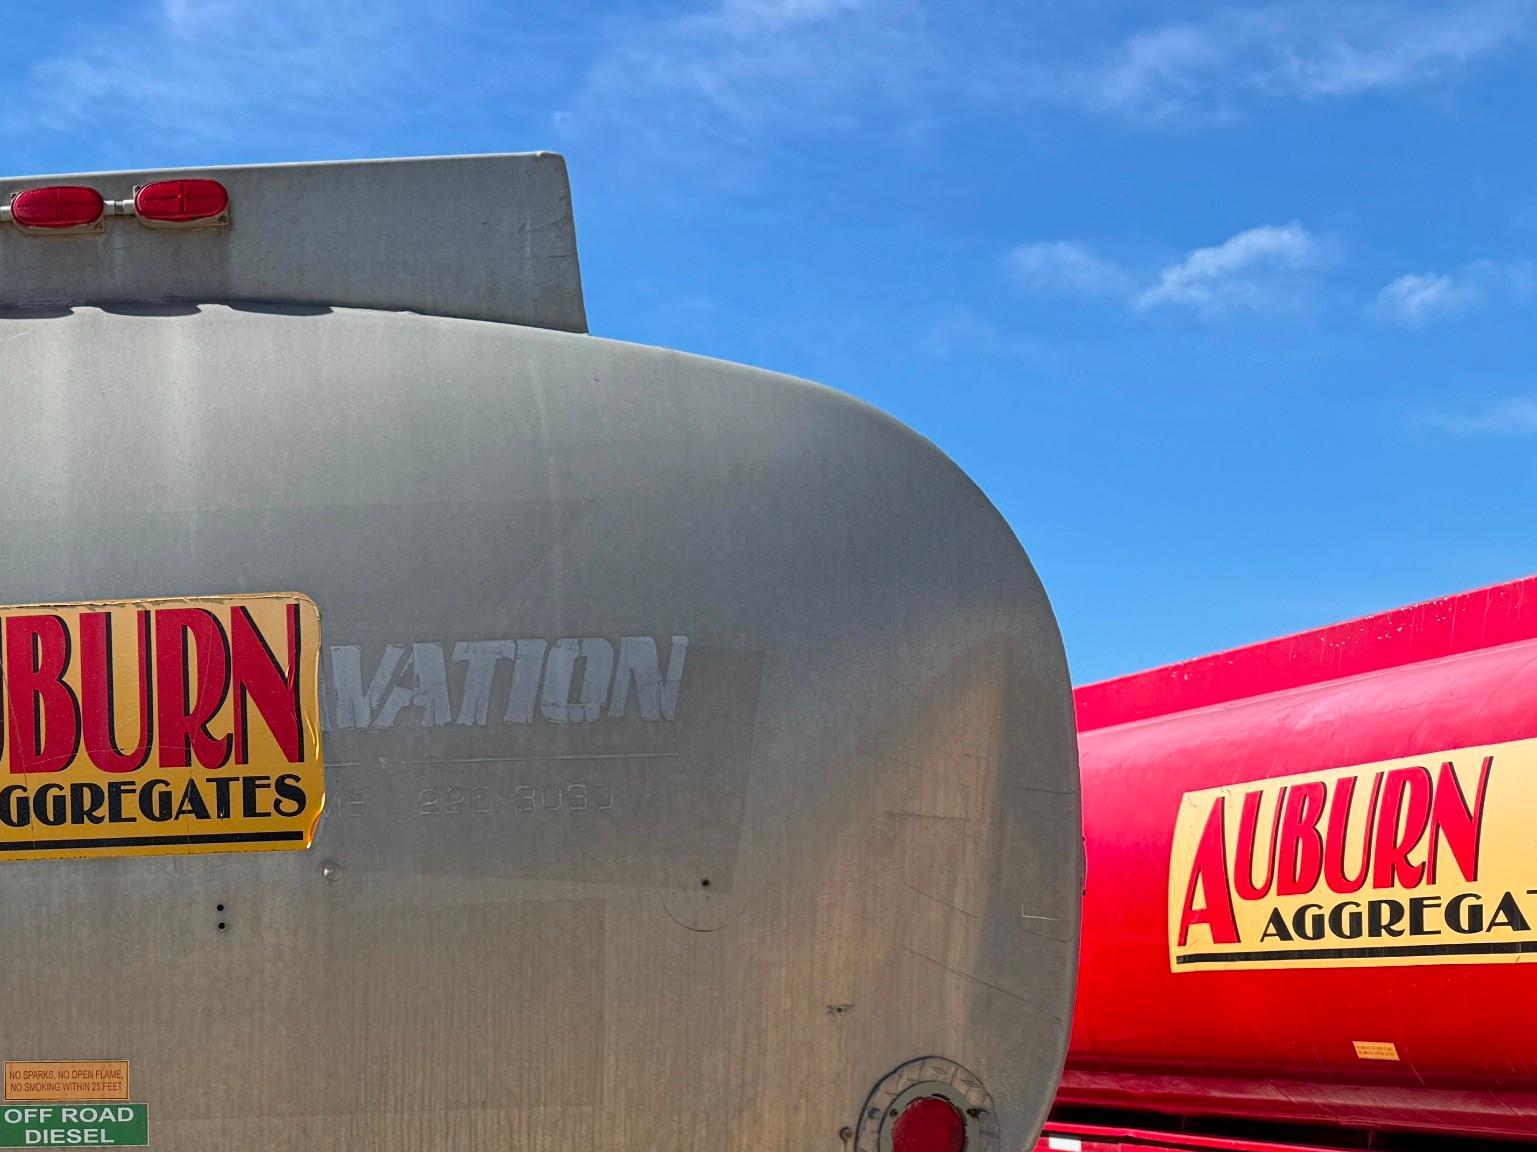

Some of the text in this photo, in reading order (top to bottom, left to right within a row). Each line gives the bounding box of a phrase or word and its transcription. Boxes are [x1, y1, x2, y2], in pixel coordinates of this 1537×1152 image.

[321, 635, 690, 729] VATION
[1177, 756, 1494, 947] AUBURN
[9, 1069, 124, 1081] NO SPARKS, NO OPEN FLAME,
[10, 1081, 122, 1092] NO SMOKING WITHIN 25 FEET
[4, 1107, 134, 1124] OFF ROAD
[25, 1128, 114, 1144] DIESEL
